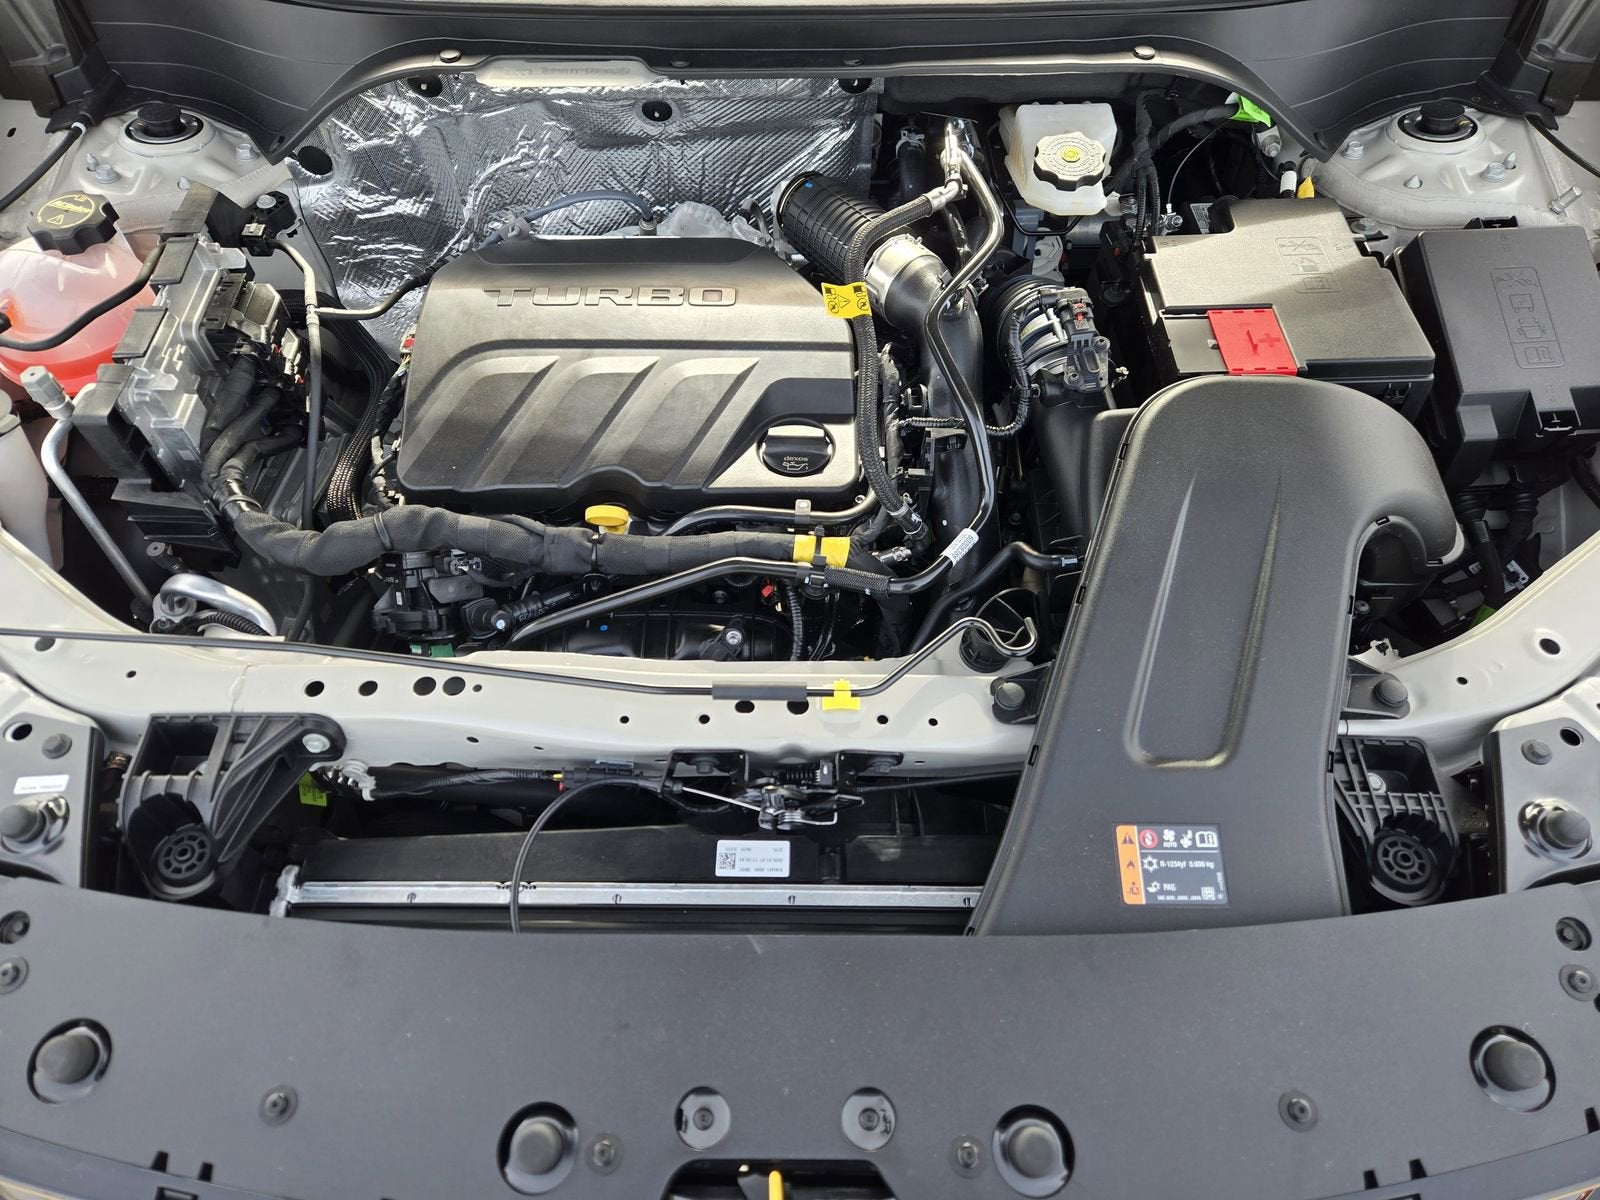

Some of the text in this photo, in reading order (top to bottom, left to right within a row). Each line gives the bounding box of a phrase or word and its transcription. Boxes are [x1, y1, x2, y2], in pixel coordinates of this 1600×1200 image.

[483, 286, 737, 307] TURBO
[1159, 860, 1187, 869] R-1234yf
[1207, 861, 1215, 869] kg
